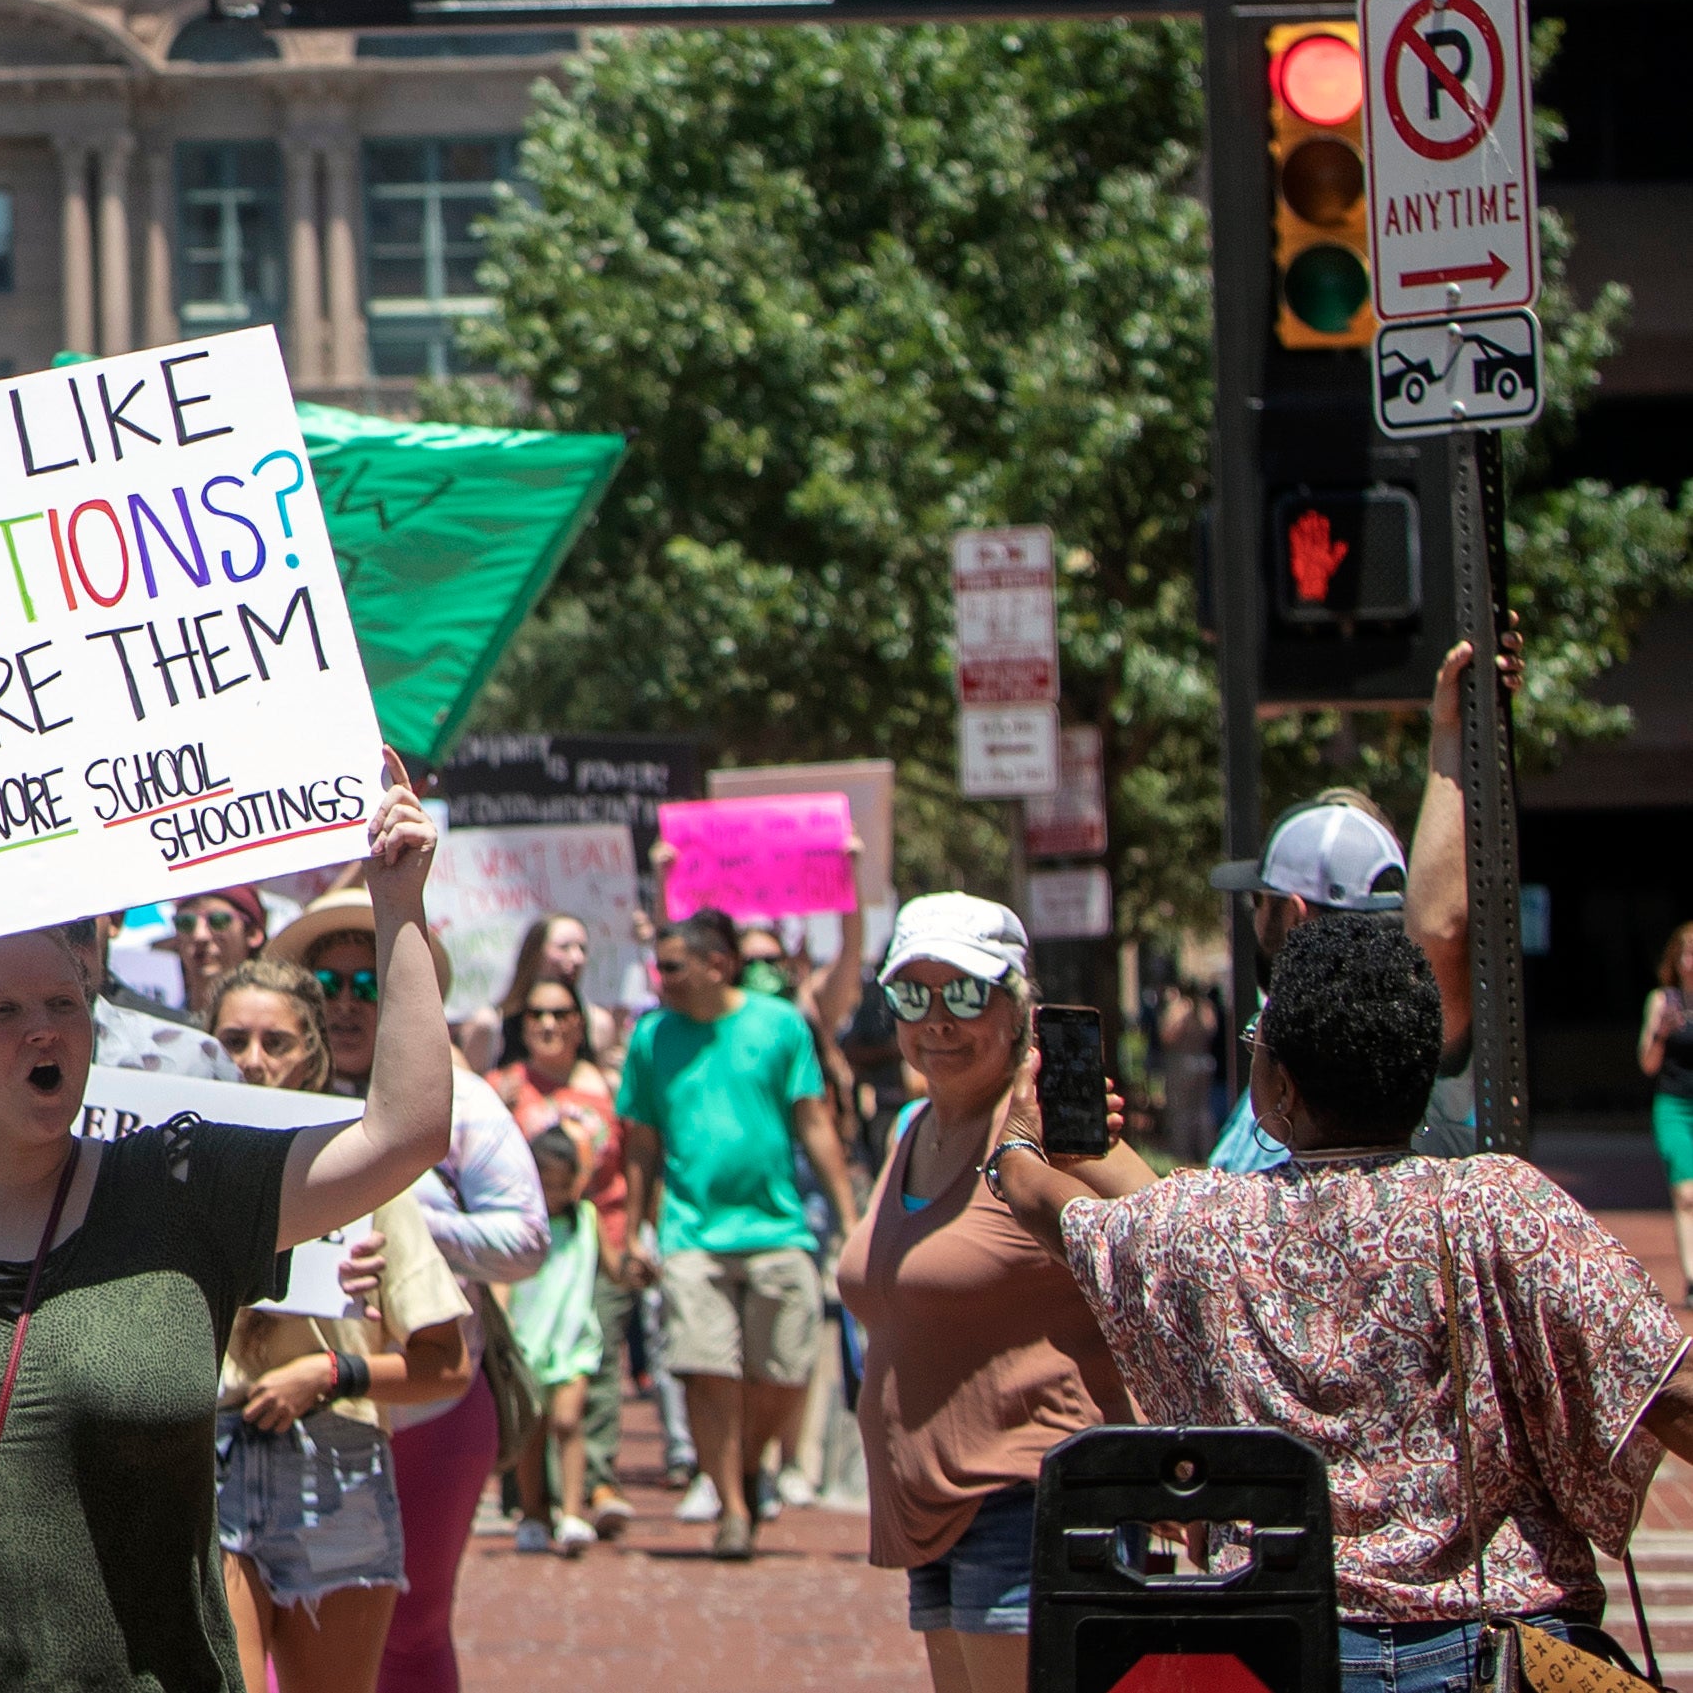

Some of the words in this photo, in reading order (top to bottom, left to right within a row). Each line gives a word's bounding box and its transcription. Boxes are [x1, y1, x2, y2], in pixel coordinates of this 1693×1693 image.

[1384, 181, 1521, 236] ANYTIME
[8, 350, 235, 476] LIKE
[85, 586, 330, 721] THEM
[83, 740, 232, 823] SCHOOL
[149, 774, 367, 864] SHOOTINGS
[83, 1105, 143, 1142] ER
